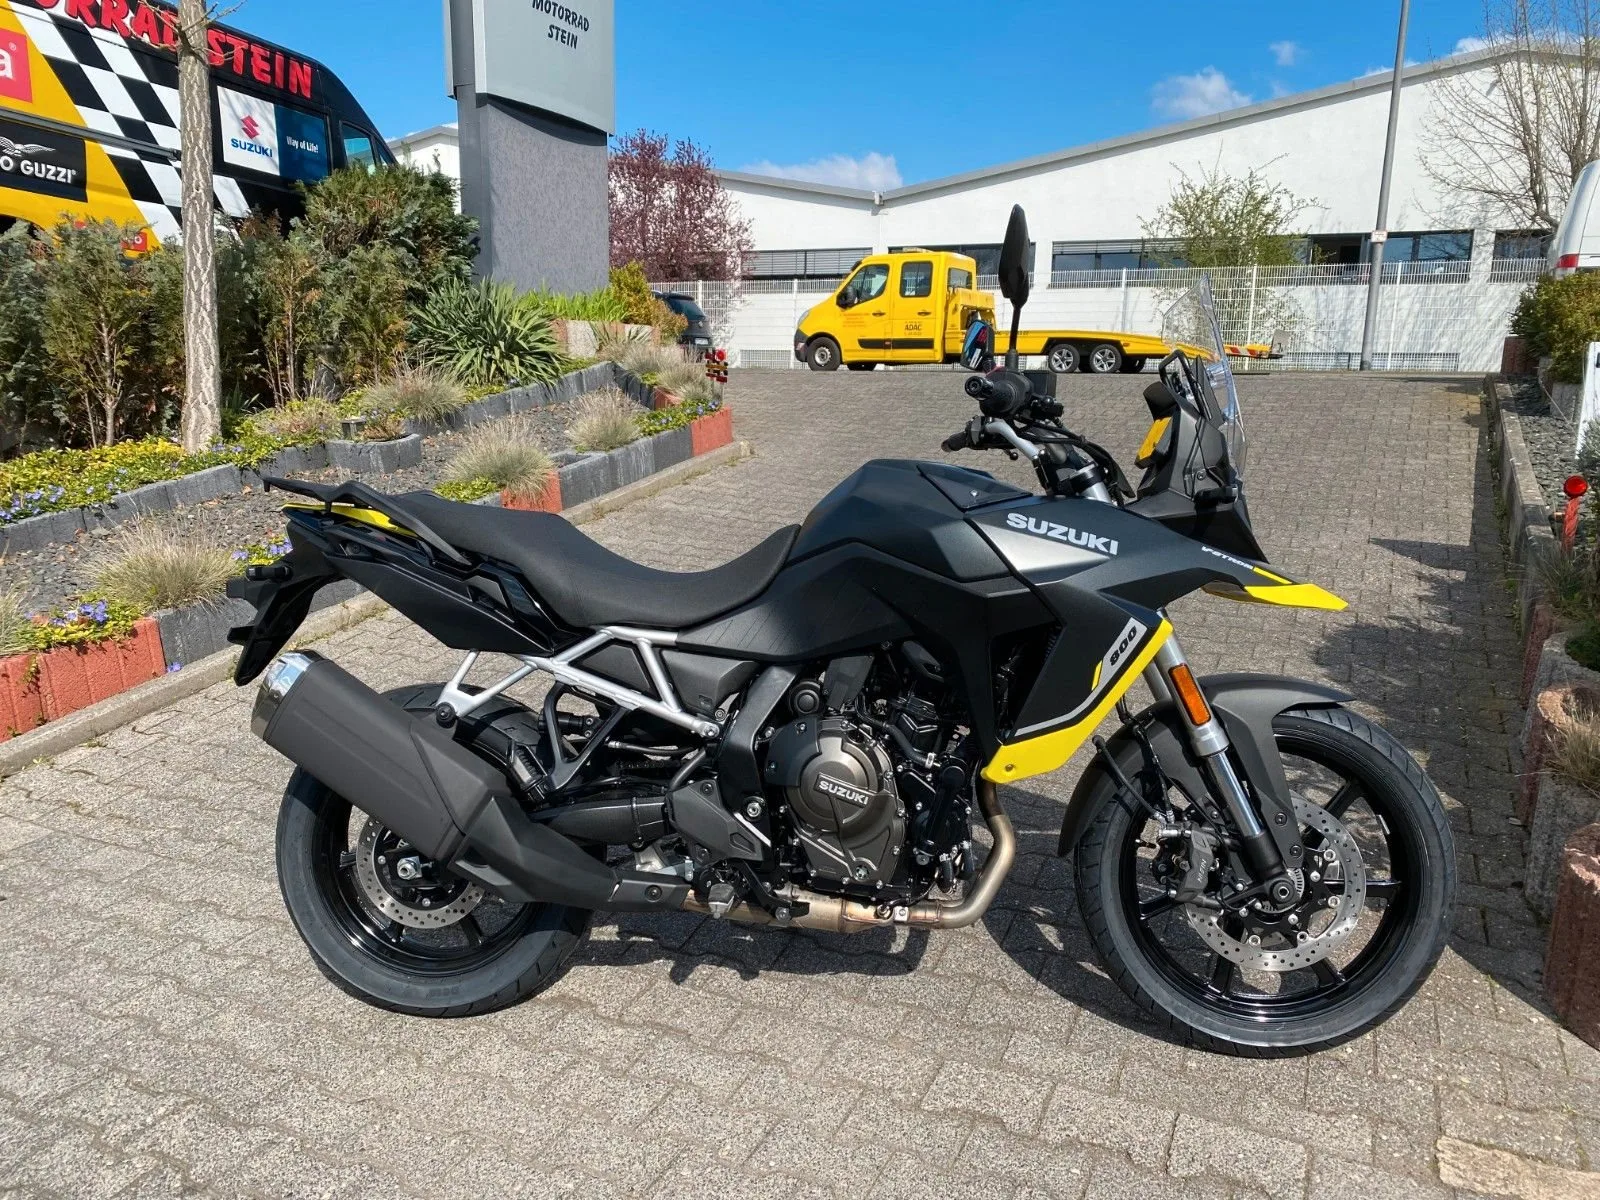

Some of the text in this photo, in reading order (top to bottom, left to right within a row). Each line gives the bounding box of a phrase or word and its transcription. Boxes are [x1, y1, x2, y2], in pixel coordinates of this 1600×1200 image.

[532, 0, 590, 32] MOTORRAD
[548, 24, 578, 50] STEIN
[208, 27, 312, 98] STEIN
[231, 138, 273, 158] SUZUKI
[286, 136, 299, 150] Way
[299, 140, 306, 150] of
[1006, 512, 1118, 555] SUZUKI
[1109, 625, 1137, 666] 800
[818, 779, 869, 805] SUZUKI
